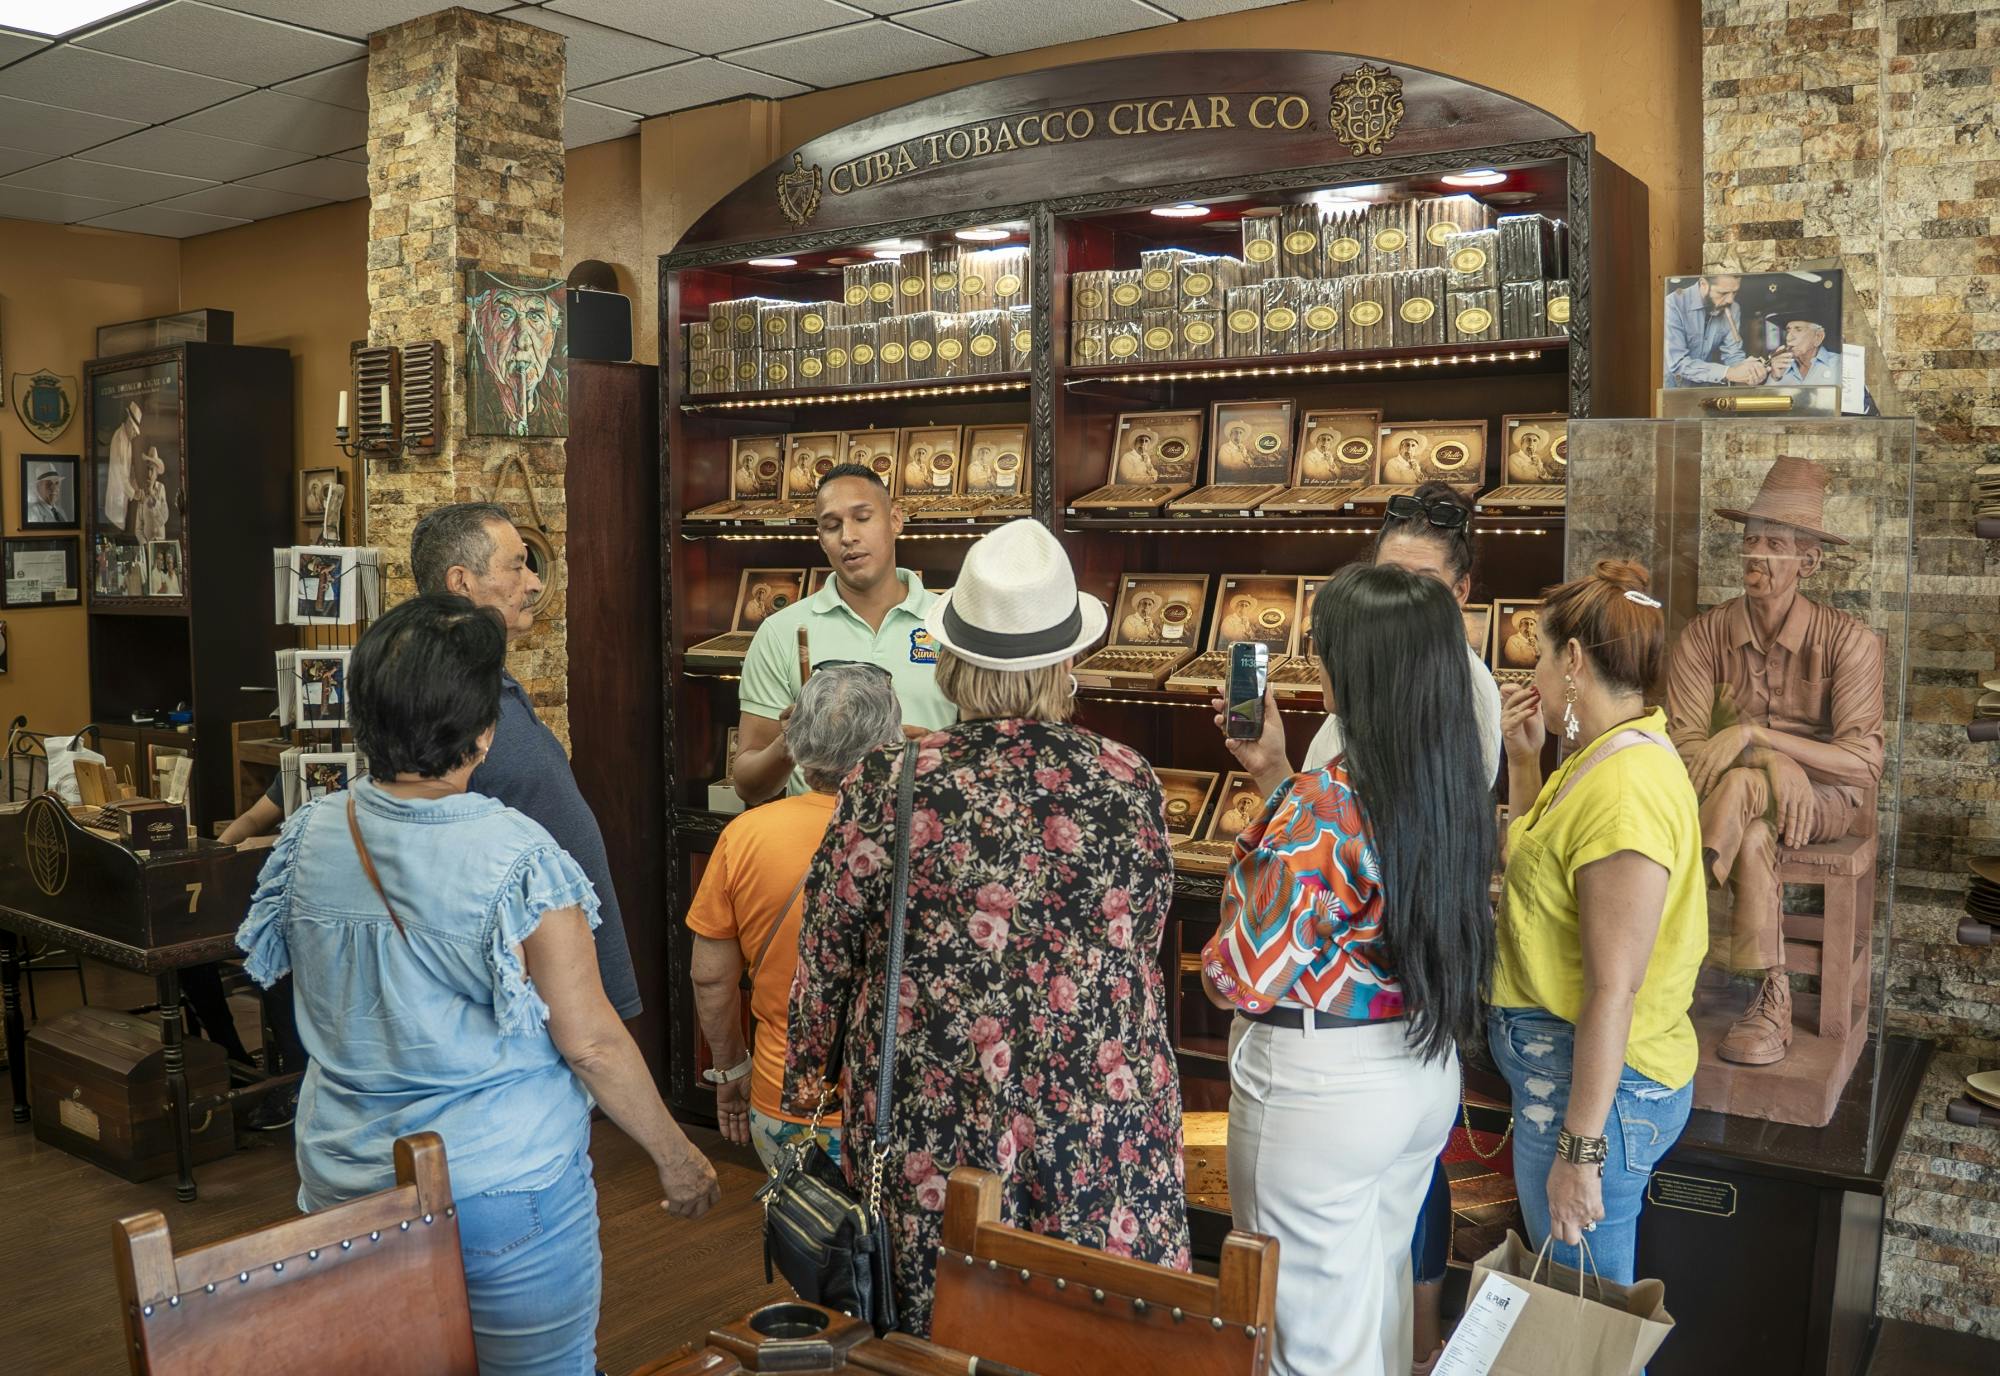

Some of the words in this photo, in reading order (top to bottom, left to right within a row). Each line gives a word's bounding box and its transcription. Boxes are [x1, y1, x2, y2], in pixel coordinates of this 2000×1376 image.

[829, 145, 918, 195] CUBA
[923, 108, 1095, 165] TOBACCO
[1108, 96, 1235, 135] CIGAR
[1248, 96, 1309, 130] CO
[185, 882, 203, 913] 7
